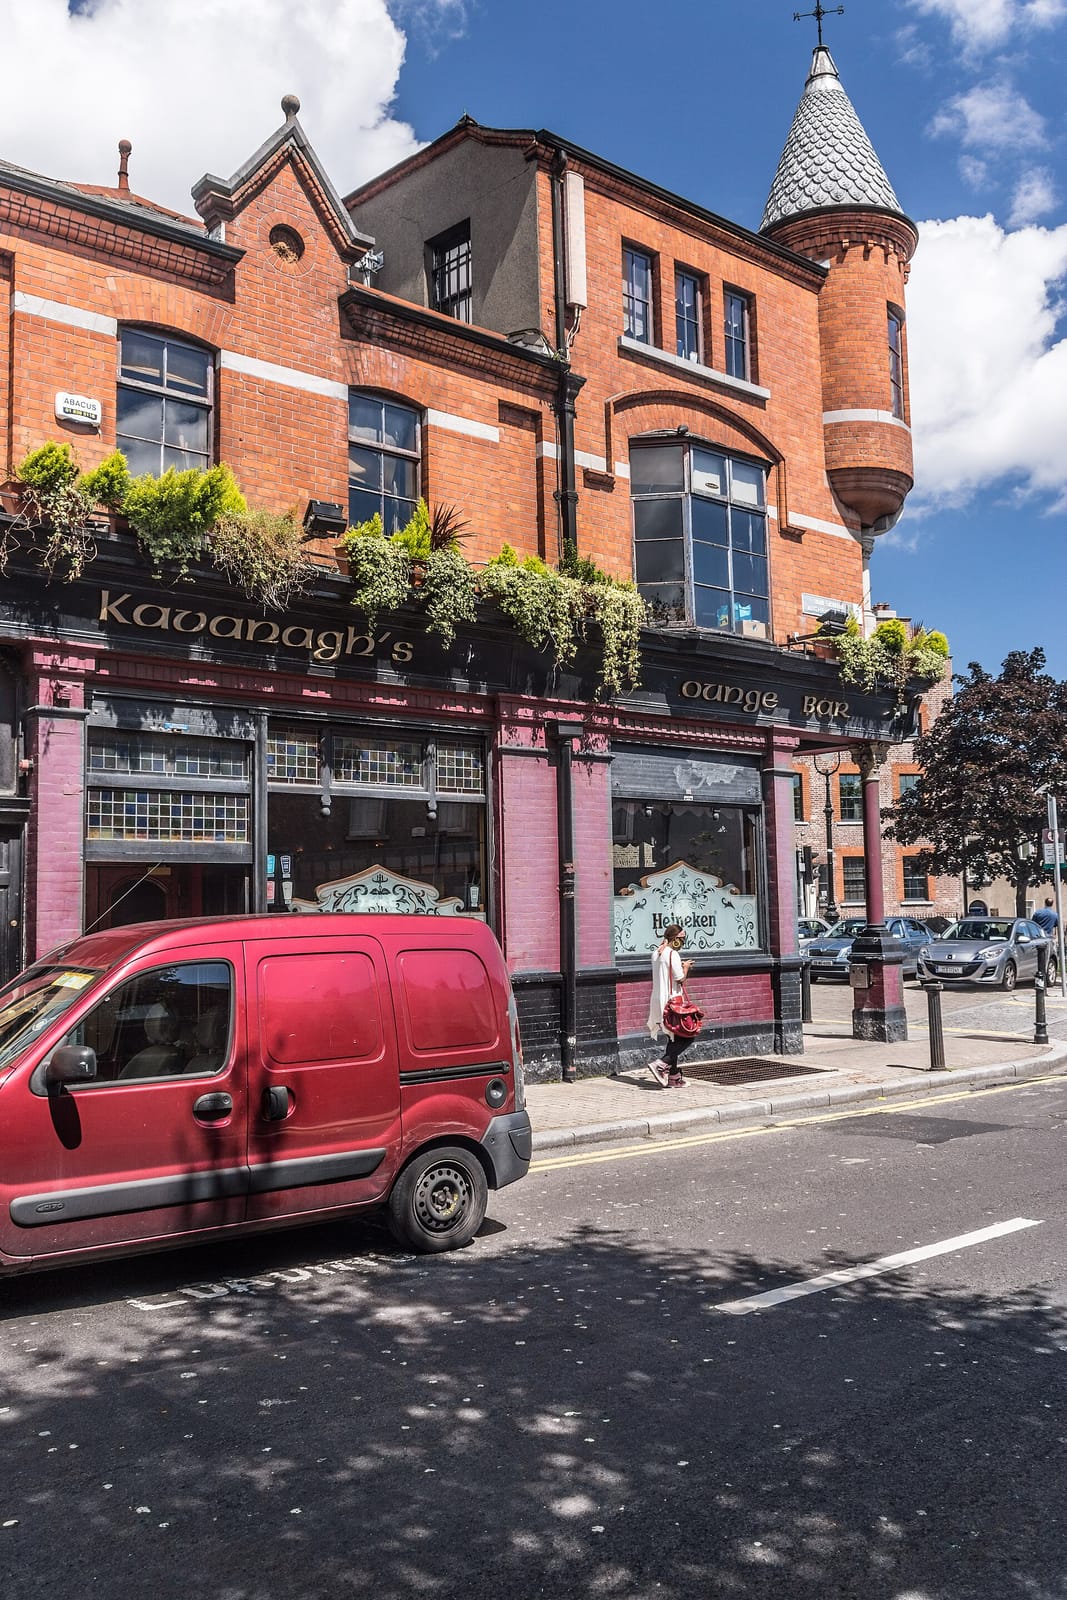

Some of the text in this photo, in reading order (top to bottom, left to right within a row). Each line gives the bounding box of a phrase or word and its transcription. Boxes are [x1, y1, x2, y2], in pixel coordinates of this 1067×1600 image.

[64, 398, 97, 411] ABACUS
[98, 589, 415, 663] Kavanagh's
[652, 911, 717, 930] Heineken
